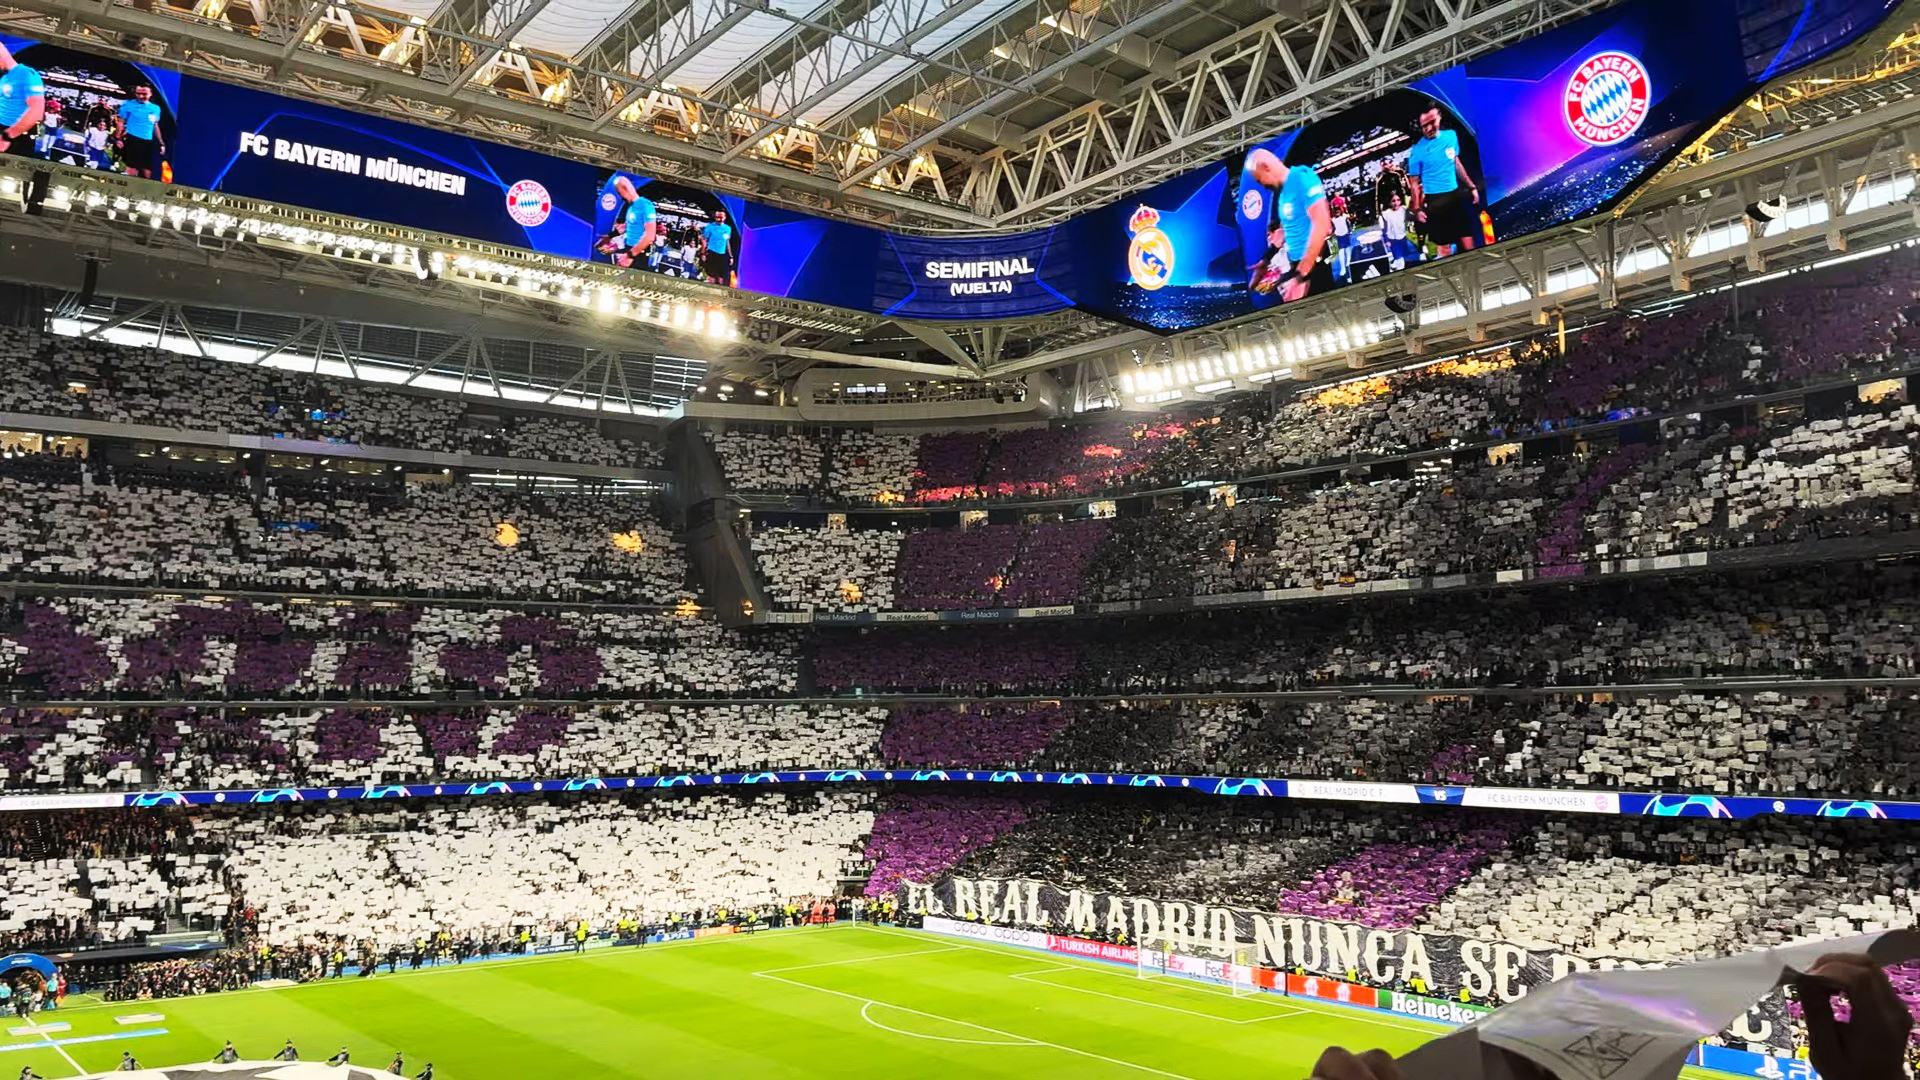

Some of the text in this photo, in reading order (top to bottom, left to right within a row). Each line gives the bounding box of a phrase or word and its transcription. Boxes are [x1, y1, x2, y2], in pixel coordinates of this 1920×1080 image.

[1568, 57, 1642, 102] FC BAYERN
[239, 131, 466, 195] FC BAYERN MÜNCHEN
[925, 257, 1035, 279] SEMIFINAL
[950, 279, 1013, 297] (VUELTA)
[961, 610, 999, 619] Real Madrid
[1313, 785, 1334, 796] REAL
[1335, 787, 1368, 798] MADRID
[1433, 790, 1448, 801] VS
[1487, 793, 1498, 803] FC
[1500, 794, 1536, 806] BAYERN
[907, 885, 944, 915] EL
[953, 878, 1052, 926] REAL
[1063, 889, 1237, 958] MADRID
[1251, 914, 1439, 991] NUNCA
[1459, 939, 1528, 1004] SE
[1060, 937, 1100, 955] TURKISH
[1152, 952, 1185, 971] FedEx
